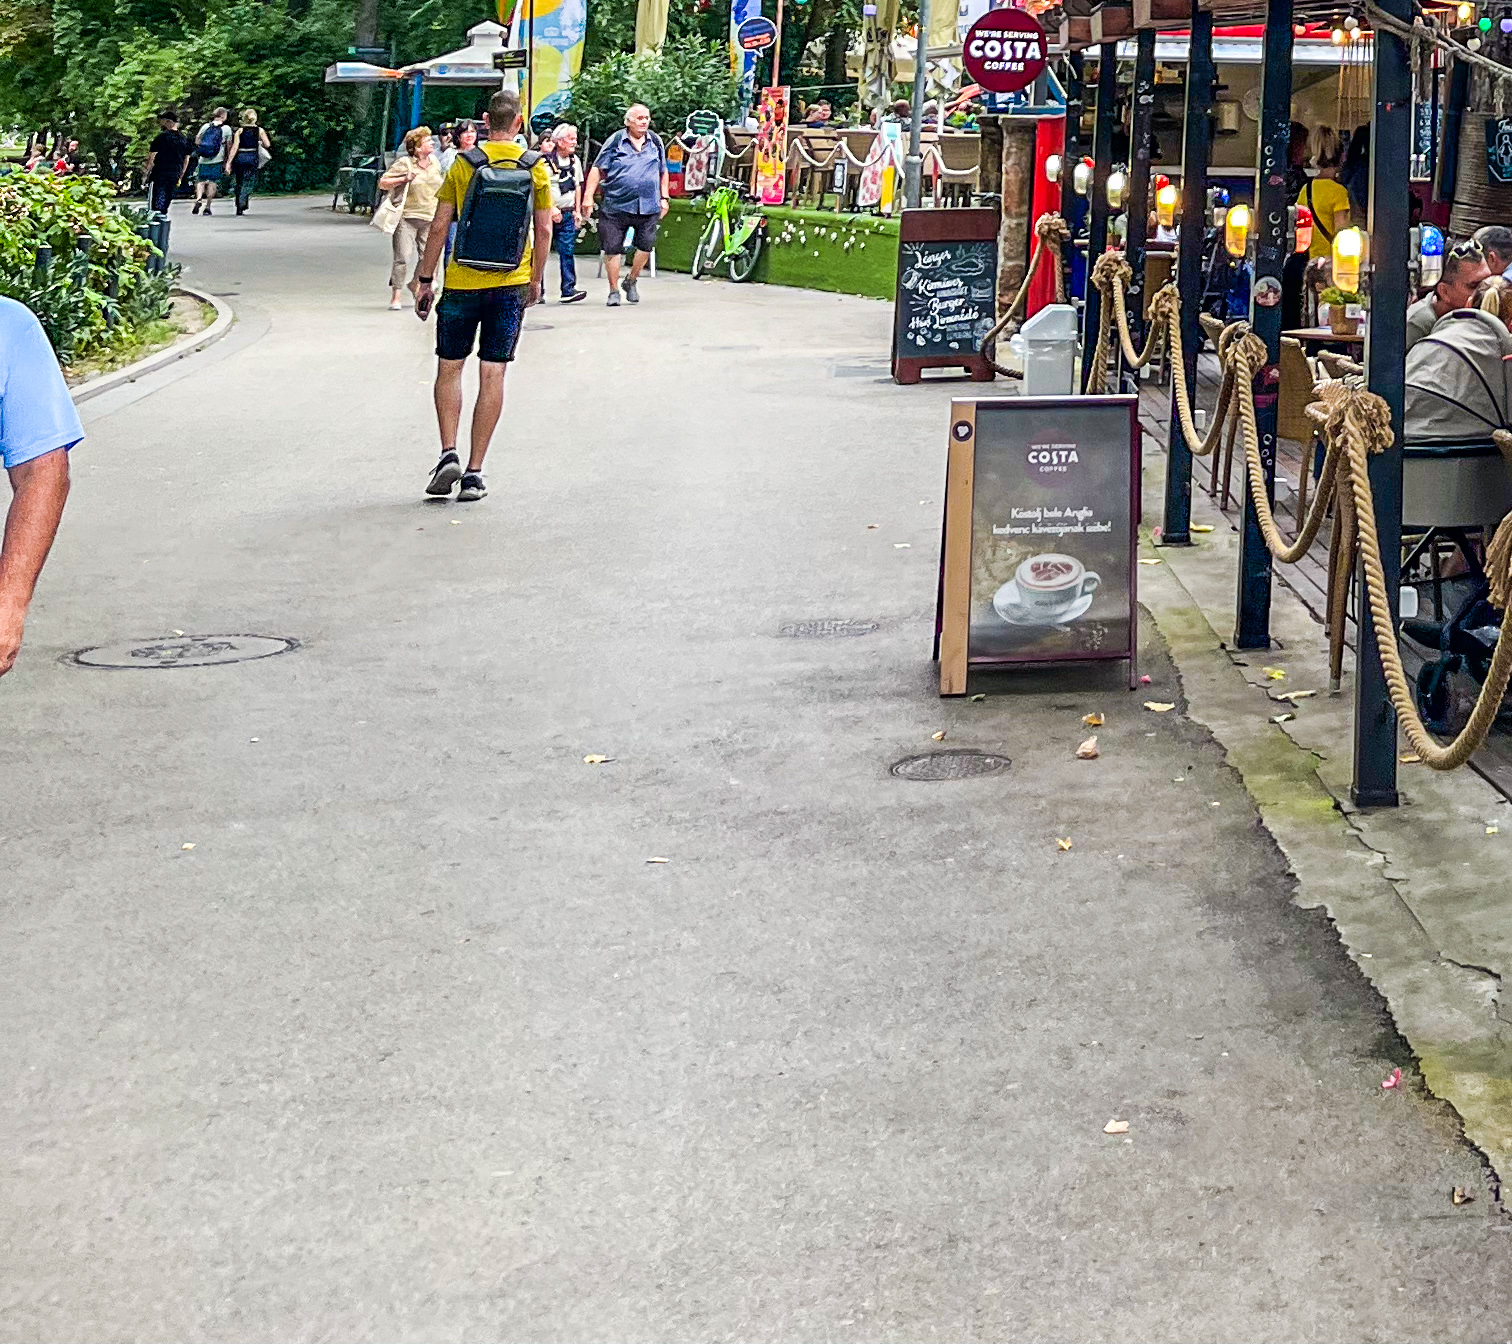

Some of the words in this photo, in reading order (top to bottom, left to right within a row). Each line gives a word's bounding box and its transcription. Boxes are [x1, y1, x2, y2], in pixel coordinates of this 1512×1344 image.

[969, 39, 1042, 61] COSTA
[984, 61, 1024, 71] COFFEE
[928, 297, 966, 316] Burger
[1027, 450, 1079, 465] COSTA
